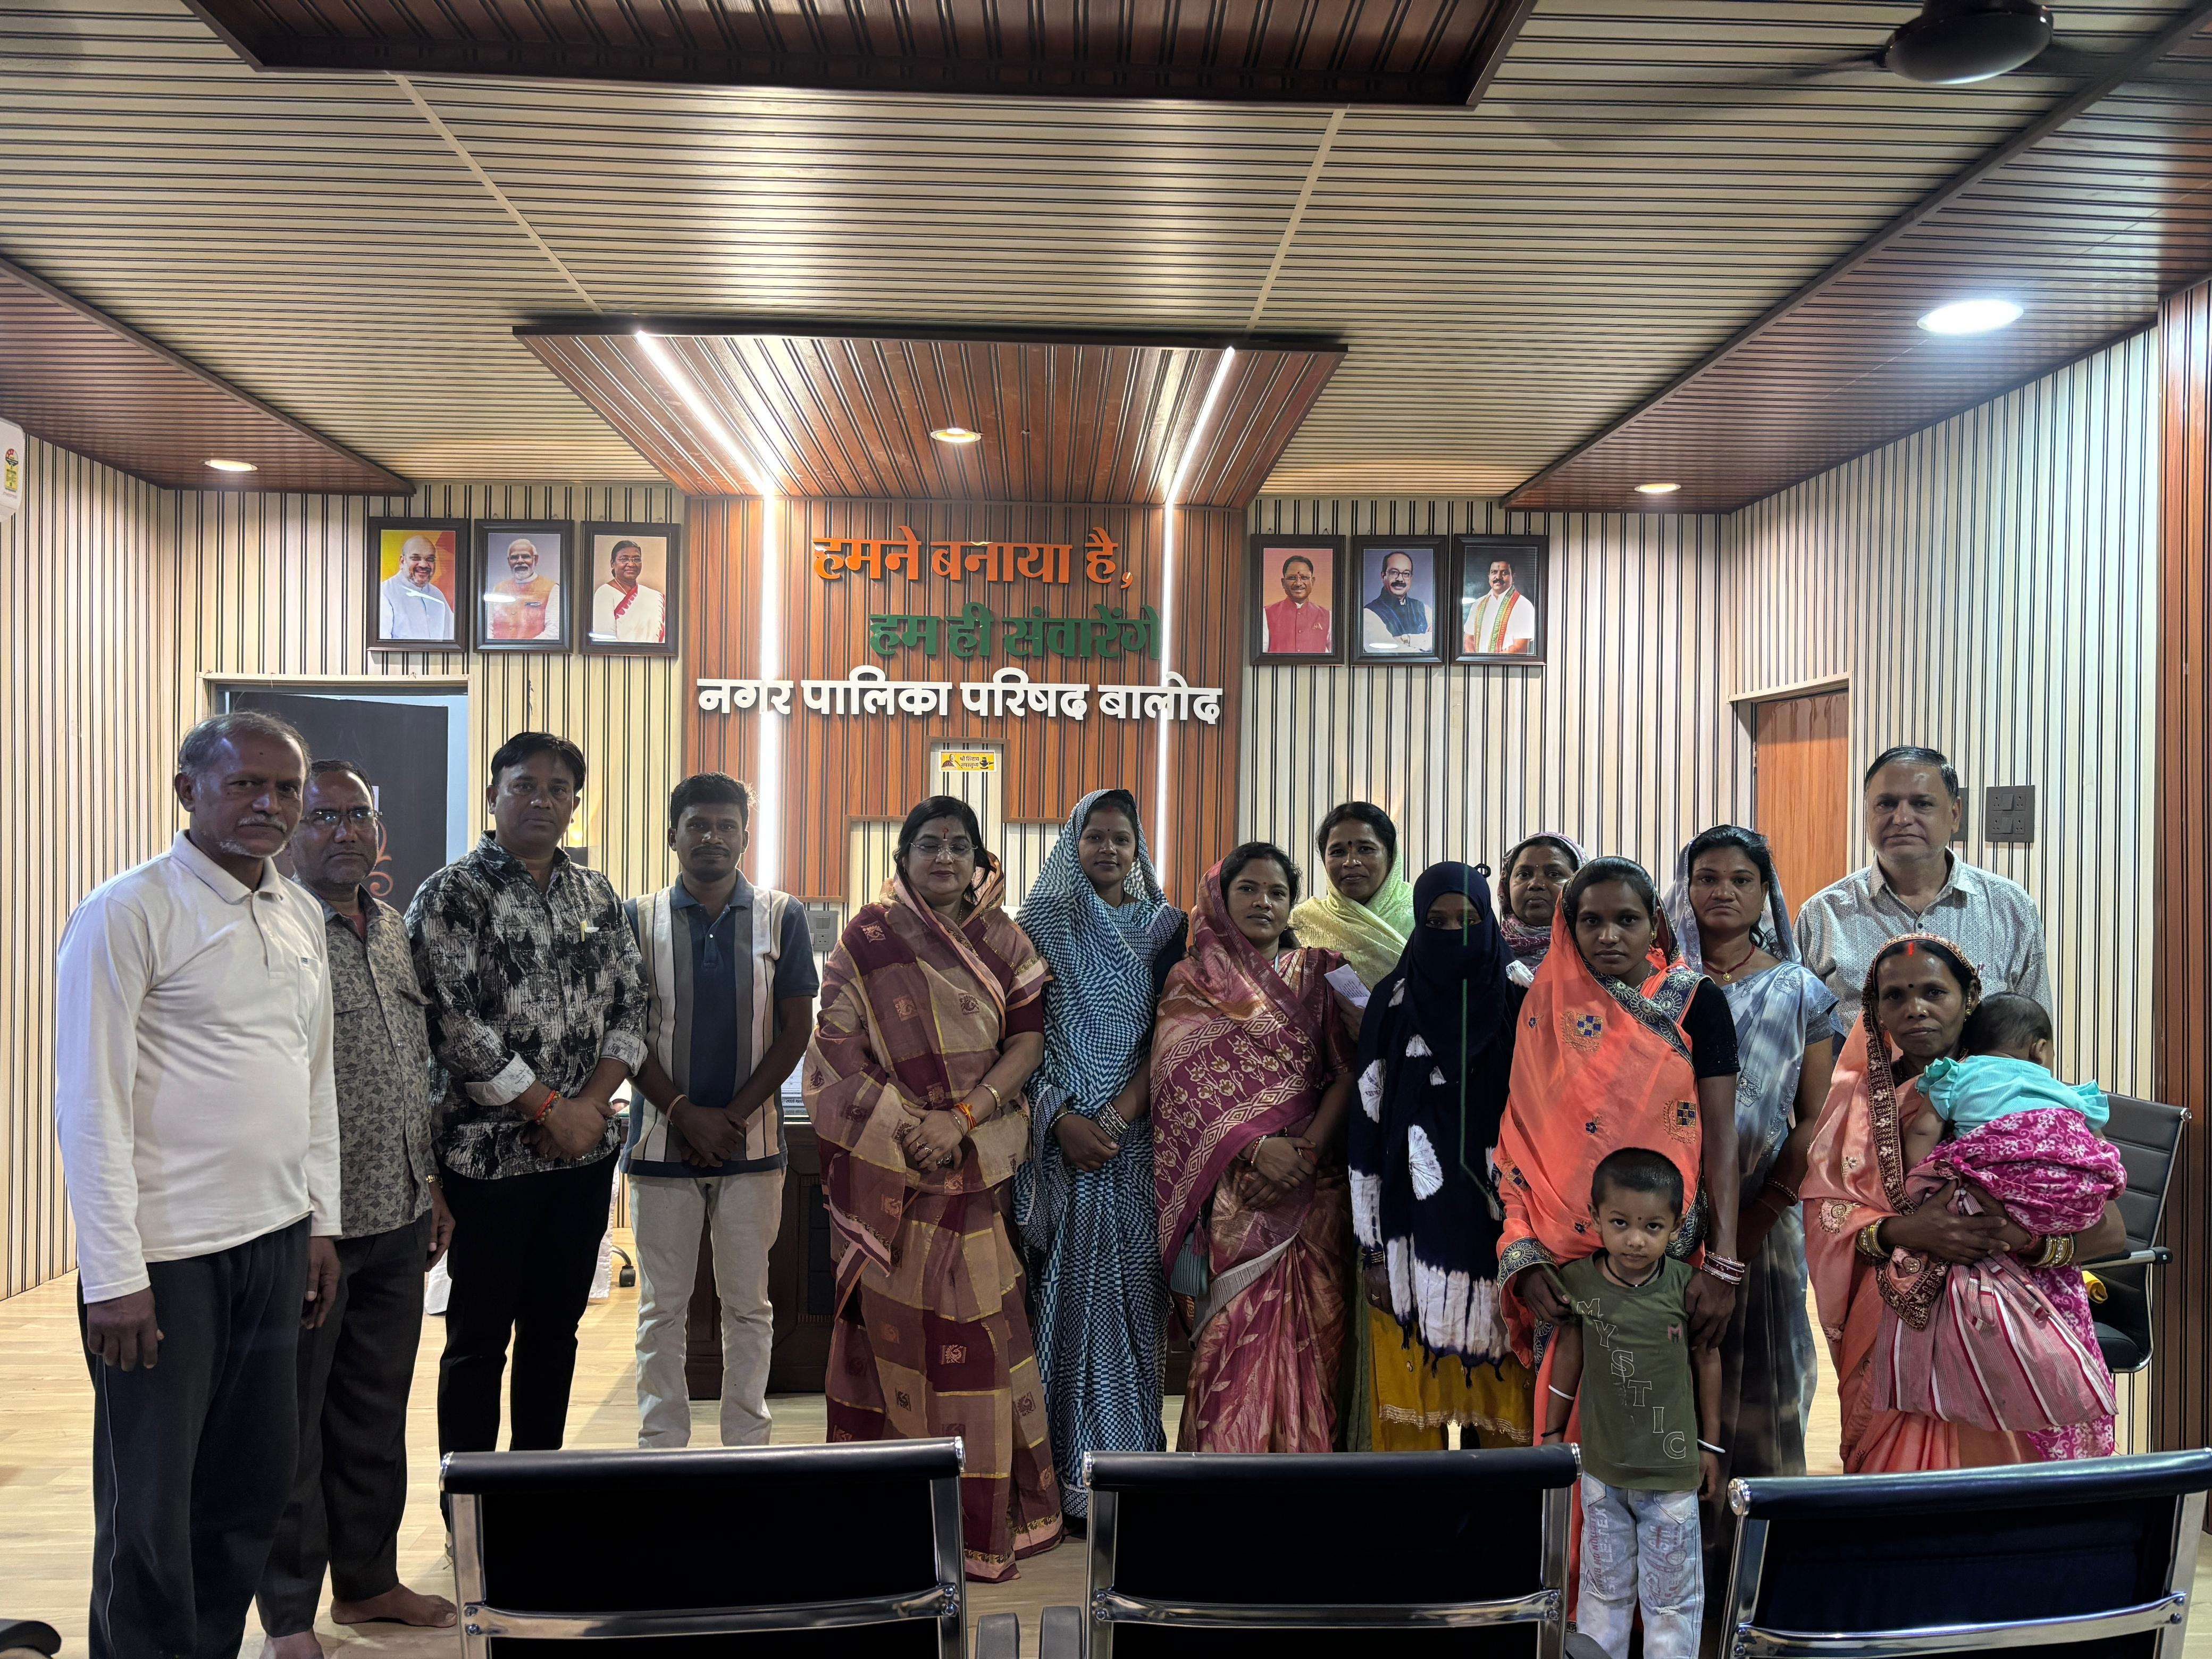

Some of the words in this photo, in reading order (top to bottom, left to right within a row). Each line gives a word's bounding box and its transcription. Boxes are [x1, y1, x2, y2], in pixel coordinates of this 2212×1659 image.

[812, 525, 922, 581] हमने
[930, 540, 1073, 583] बनाया
[1084, 526, 1134, 589] है,
[868, 613, 941, 656] हम
[945, 601, 994, 658] ही
[1001, 604, 1161, 660] संवारेंगे
[697, 678, 794, 715] नगर
[800, 664, 953, 716] पालिका
[959, 666, 1090, 721] परिषद
[1097, 671, 1222, 725] बालोद
[1576, 1297, 1687, 1460] MYSTIC
